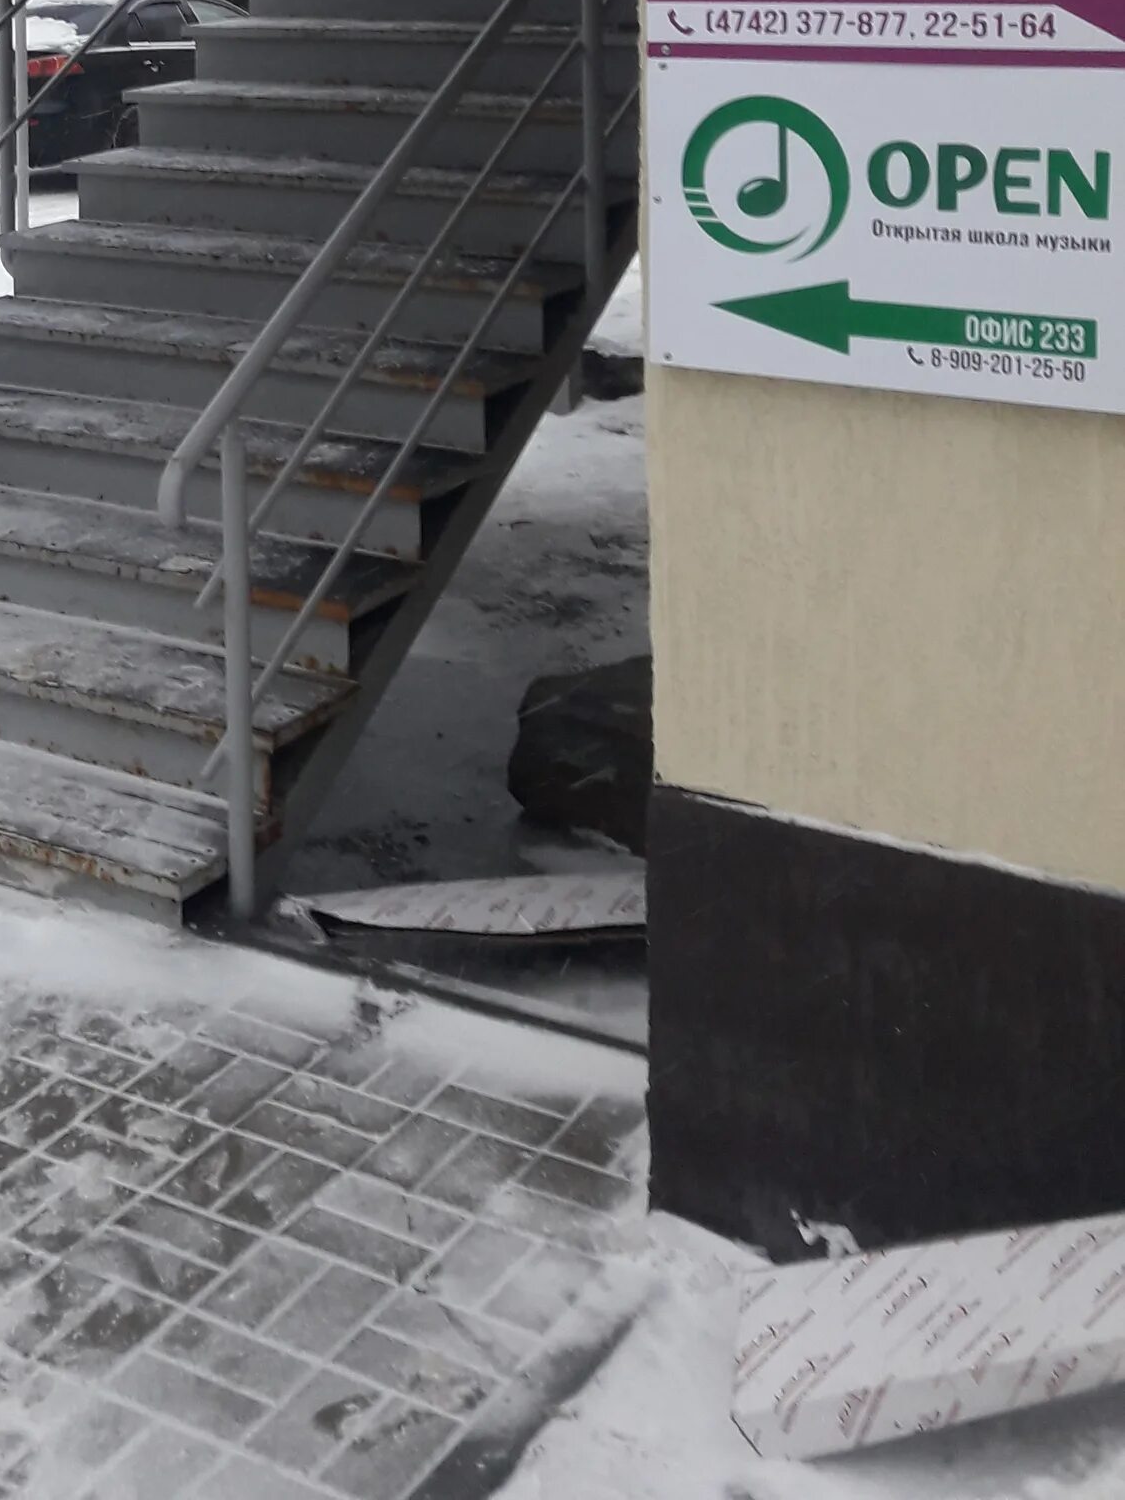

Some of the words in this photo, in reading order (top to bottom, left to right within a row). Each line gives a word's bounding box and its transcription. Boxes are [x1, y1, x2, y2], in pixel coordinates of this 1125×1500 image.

[705, 9, 788, 36] (4742)
[796, 9, 916, 40] 377-877,
[924, 11, 1057, 39] 22-51-64
[866, 140, 1112, 221] OPEN
[872, 218, 962, 245] Открытая
[967, 226, 1030, 248] школа
[1036, 234, 1112, 255] музыки
[964, 314, 1034, 349] ОФИС
[1038, 320, 1086, 355] 233
[930, 347, 1086, 383] 8-909-201-25-50
